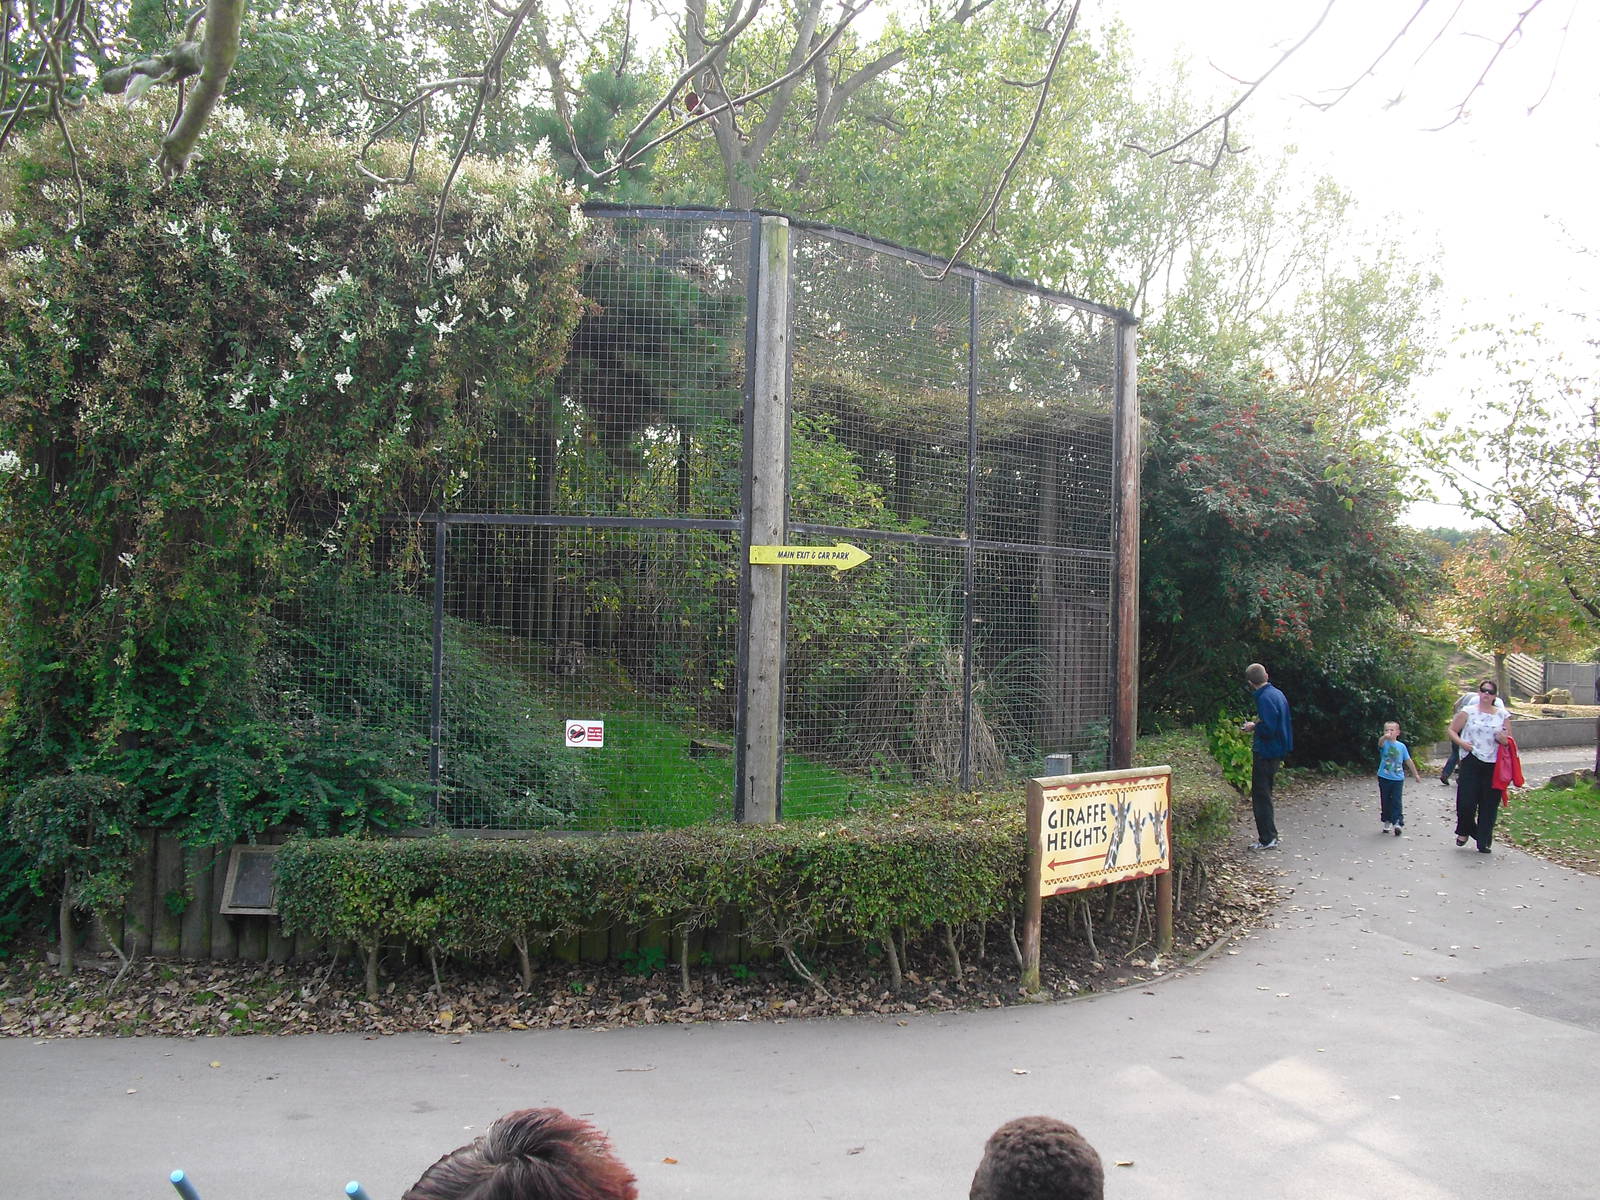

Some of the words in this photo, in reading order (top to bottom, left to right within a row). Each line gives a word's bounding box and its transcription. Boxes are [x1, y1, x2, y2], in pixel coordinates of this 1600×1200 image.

[796, 551, 810, 559] EXIT
[818, 551, 830, 560] CAR
[832, 552, 850, 560] PARK
[1048, 803, 1107, 829] GIRAFFE
[1047, 825, 1107, 852] HEIGHTS
